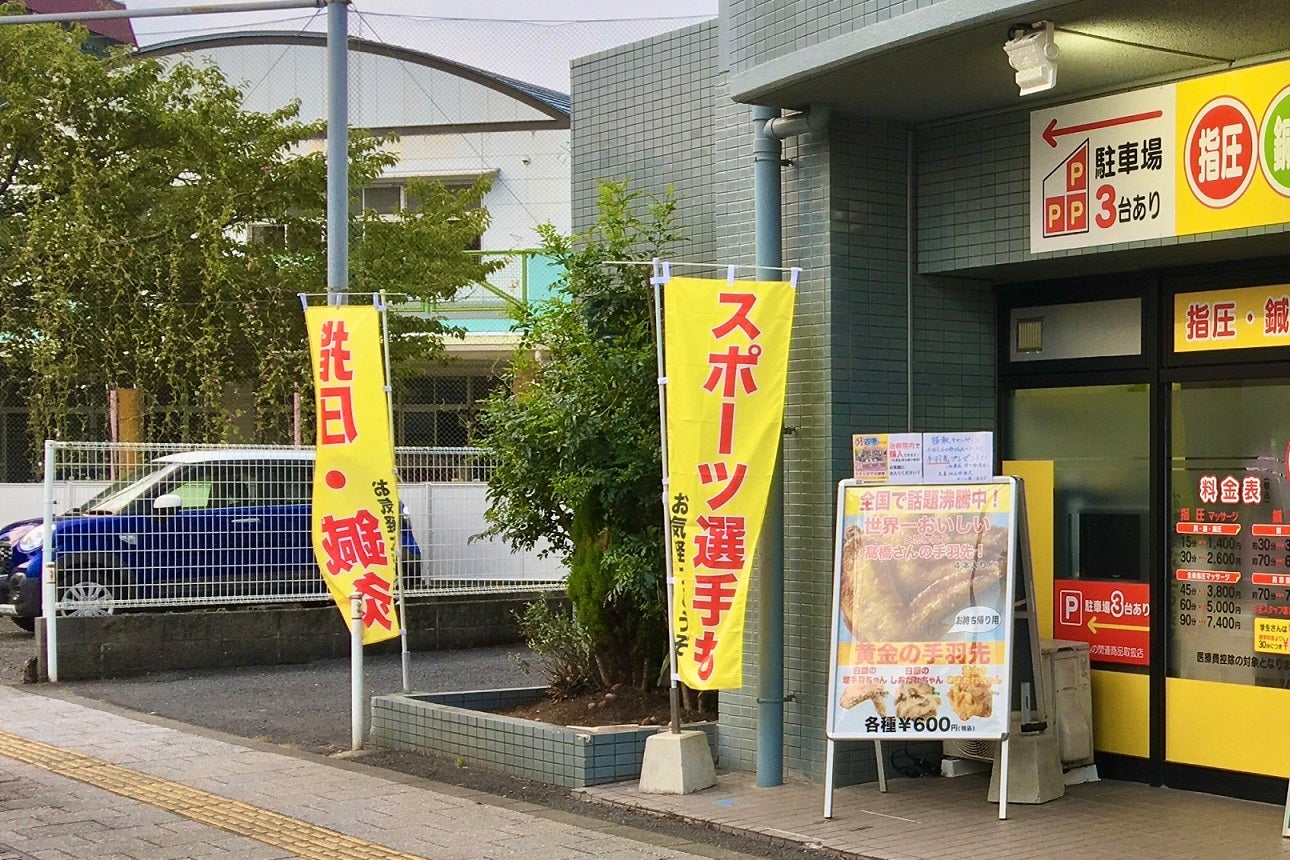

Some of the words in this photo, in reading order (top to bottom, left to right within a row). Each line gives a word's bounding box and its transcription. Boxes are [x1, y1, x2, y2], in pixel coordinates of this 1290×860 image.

[1095, 138, 1163, 180] 駐車場
[1197, 121, 1244, 185] 指圧
[1070, 161, 1083, 183] P
[1048, 206, 1061, 228] P
[1070, 201, 1083, 224] P
[1095, 184, 1161, 229] 3台あり
[692, 293, 762, 681] スポーツ選手も
[1200, 476, 1262, 504] 料金表
[860, 489, 998, 511] 全国で話題沸騰中!
[864, 515, 992, 535] 世界一おいしい
[1065, 596, 1079, 620] P
[1084, 590, 1150, 618] 駐車場3台あり
[1207, 615, 1241, 630] 7,400円
[855, 642, 992, 665] 黄金の手羽先
